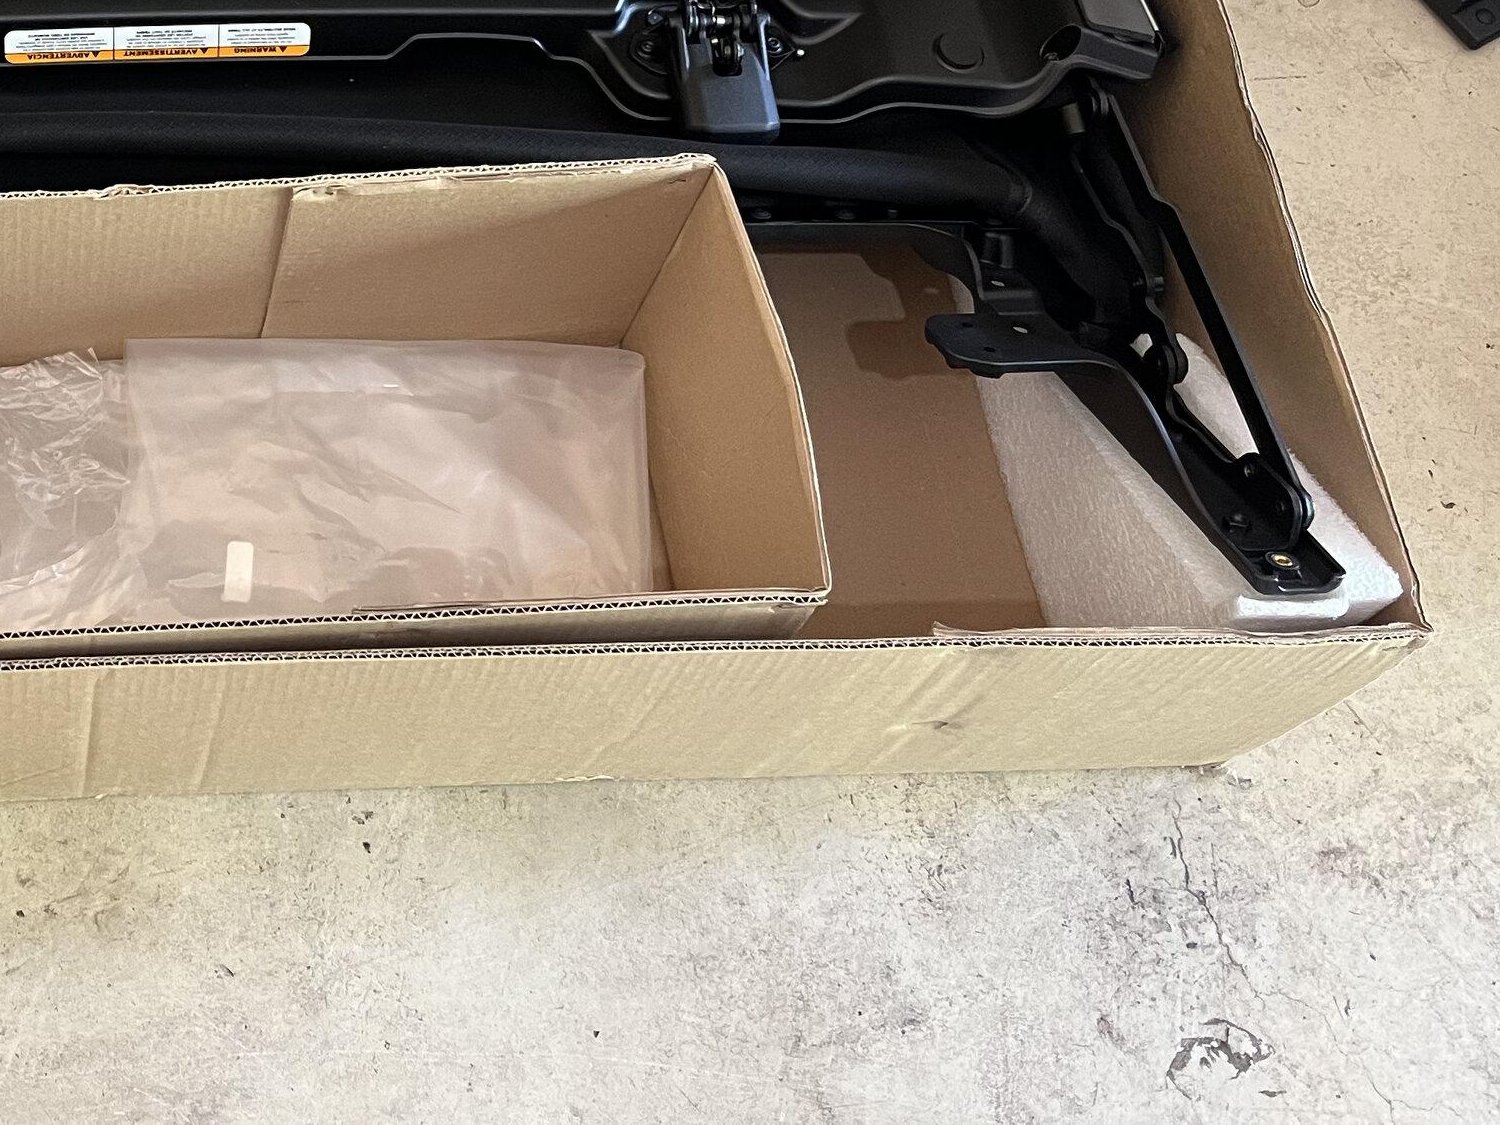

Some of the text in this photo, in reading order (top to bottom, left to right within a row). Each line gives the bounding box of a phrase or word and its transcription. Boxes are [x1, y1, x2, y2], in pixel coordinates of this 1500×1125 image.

[123, 48, 197, 57] AVERTISSEMENT
[234, 46, 277, 54] WARNING
[27, 52, 89, 60] ADVERTENCIA
